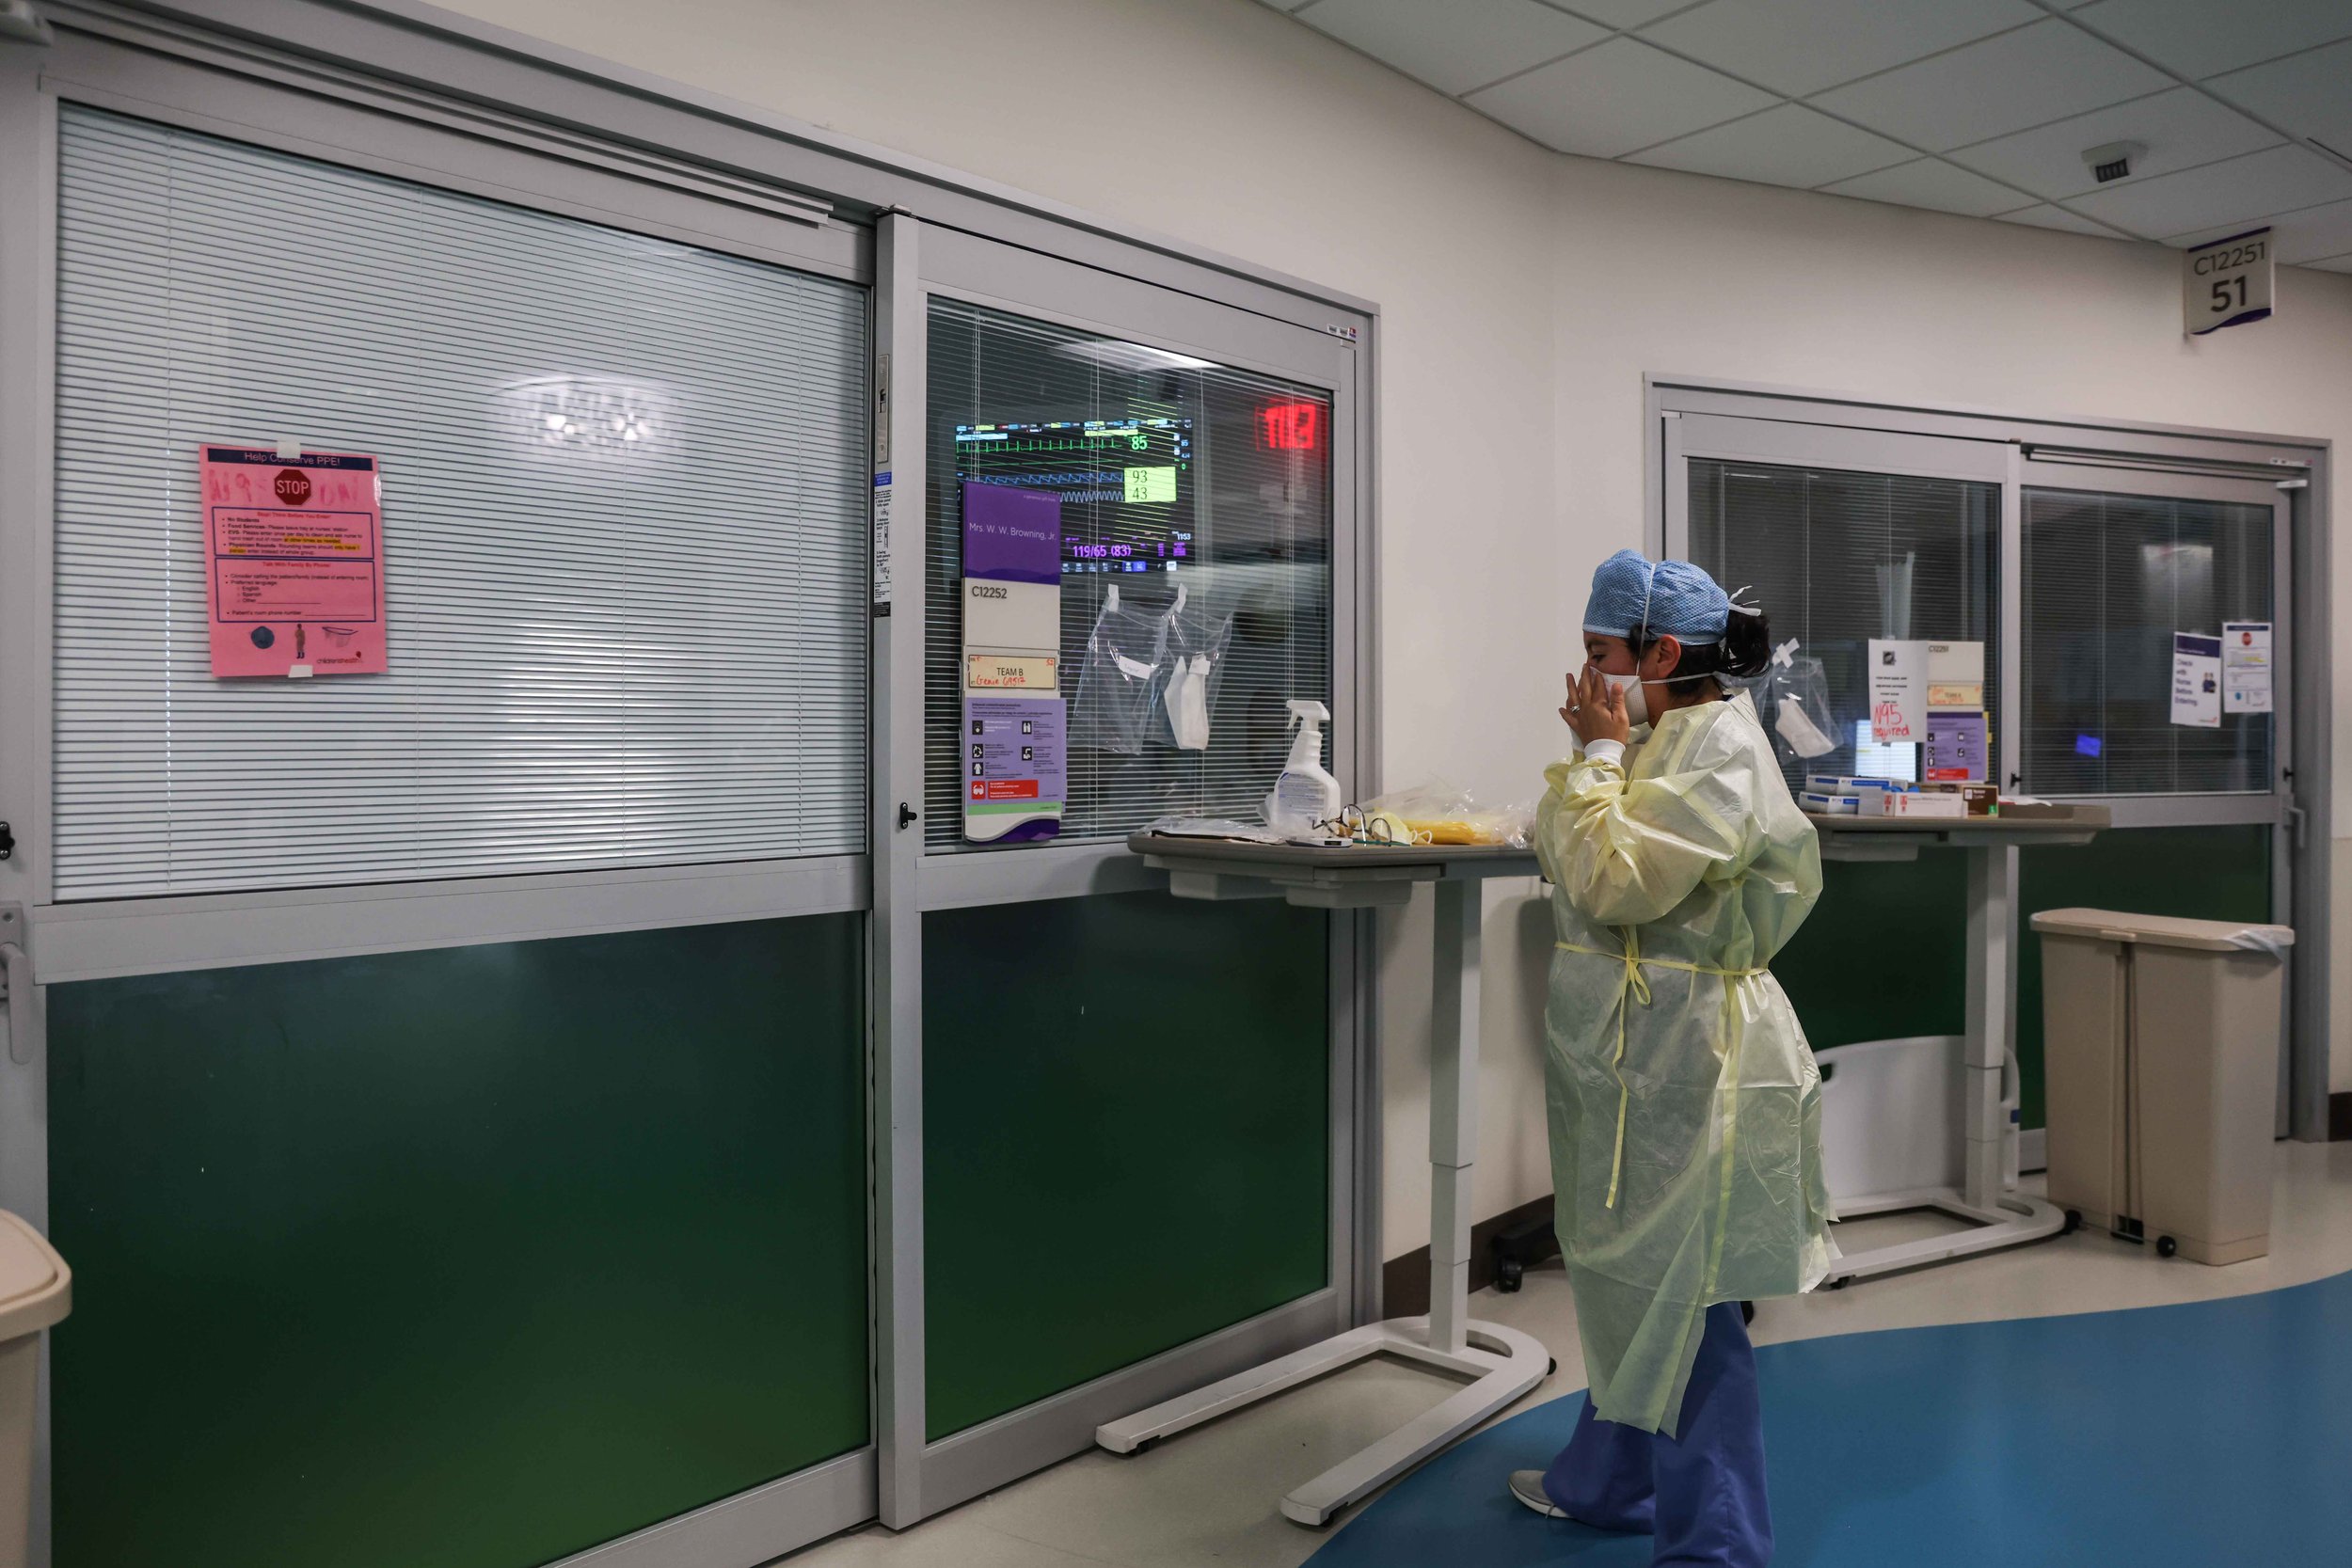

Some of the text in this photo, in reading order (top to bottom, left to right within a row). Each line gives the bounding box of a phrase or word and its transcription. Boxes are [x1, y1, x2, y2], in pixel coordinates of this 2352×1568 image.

[2193, 240, 2265, 276] C12251
[2209, 274, 2246, 312] 51
[1131, 435, 1148, 451] 85
[245, 451, 267, 463] Help
[317, 456, 341, 466] PPE!
[1132, 470, 1148, 483] 93
[276, 480, 309, 494] STOP
[1132, 486, 1148, 499] 43
[997, 526, 1009, 535] W.
[1010, 527, 1046, 540] Browning,
[1073, 545, 1131, 558] 119/65 (83)
[971, 585, 1008, 599] C12252
[996, 667, 1024, 676] TEAM B
[1873, 703, 1902, 725] N95
[1873, 724, 1910, 741] required
